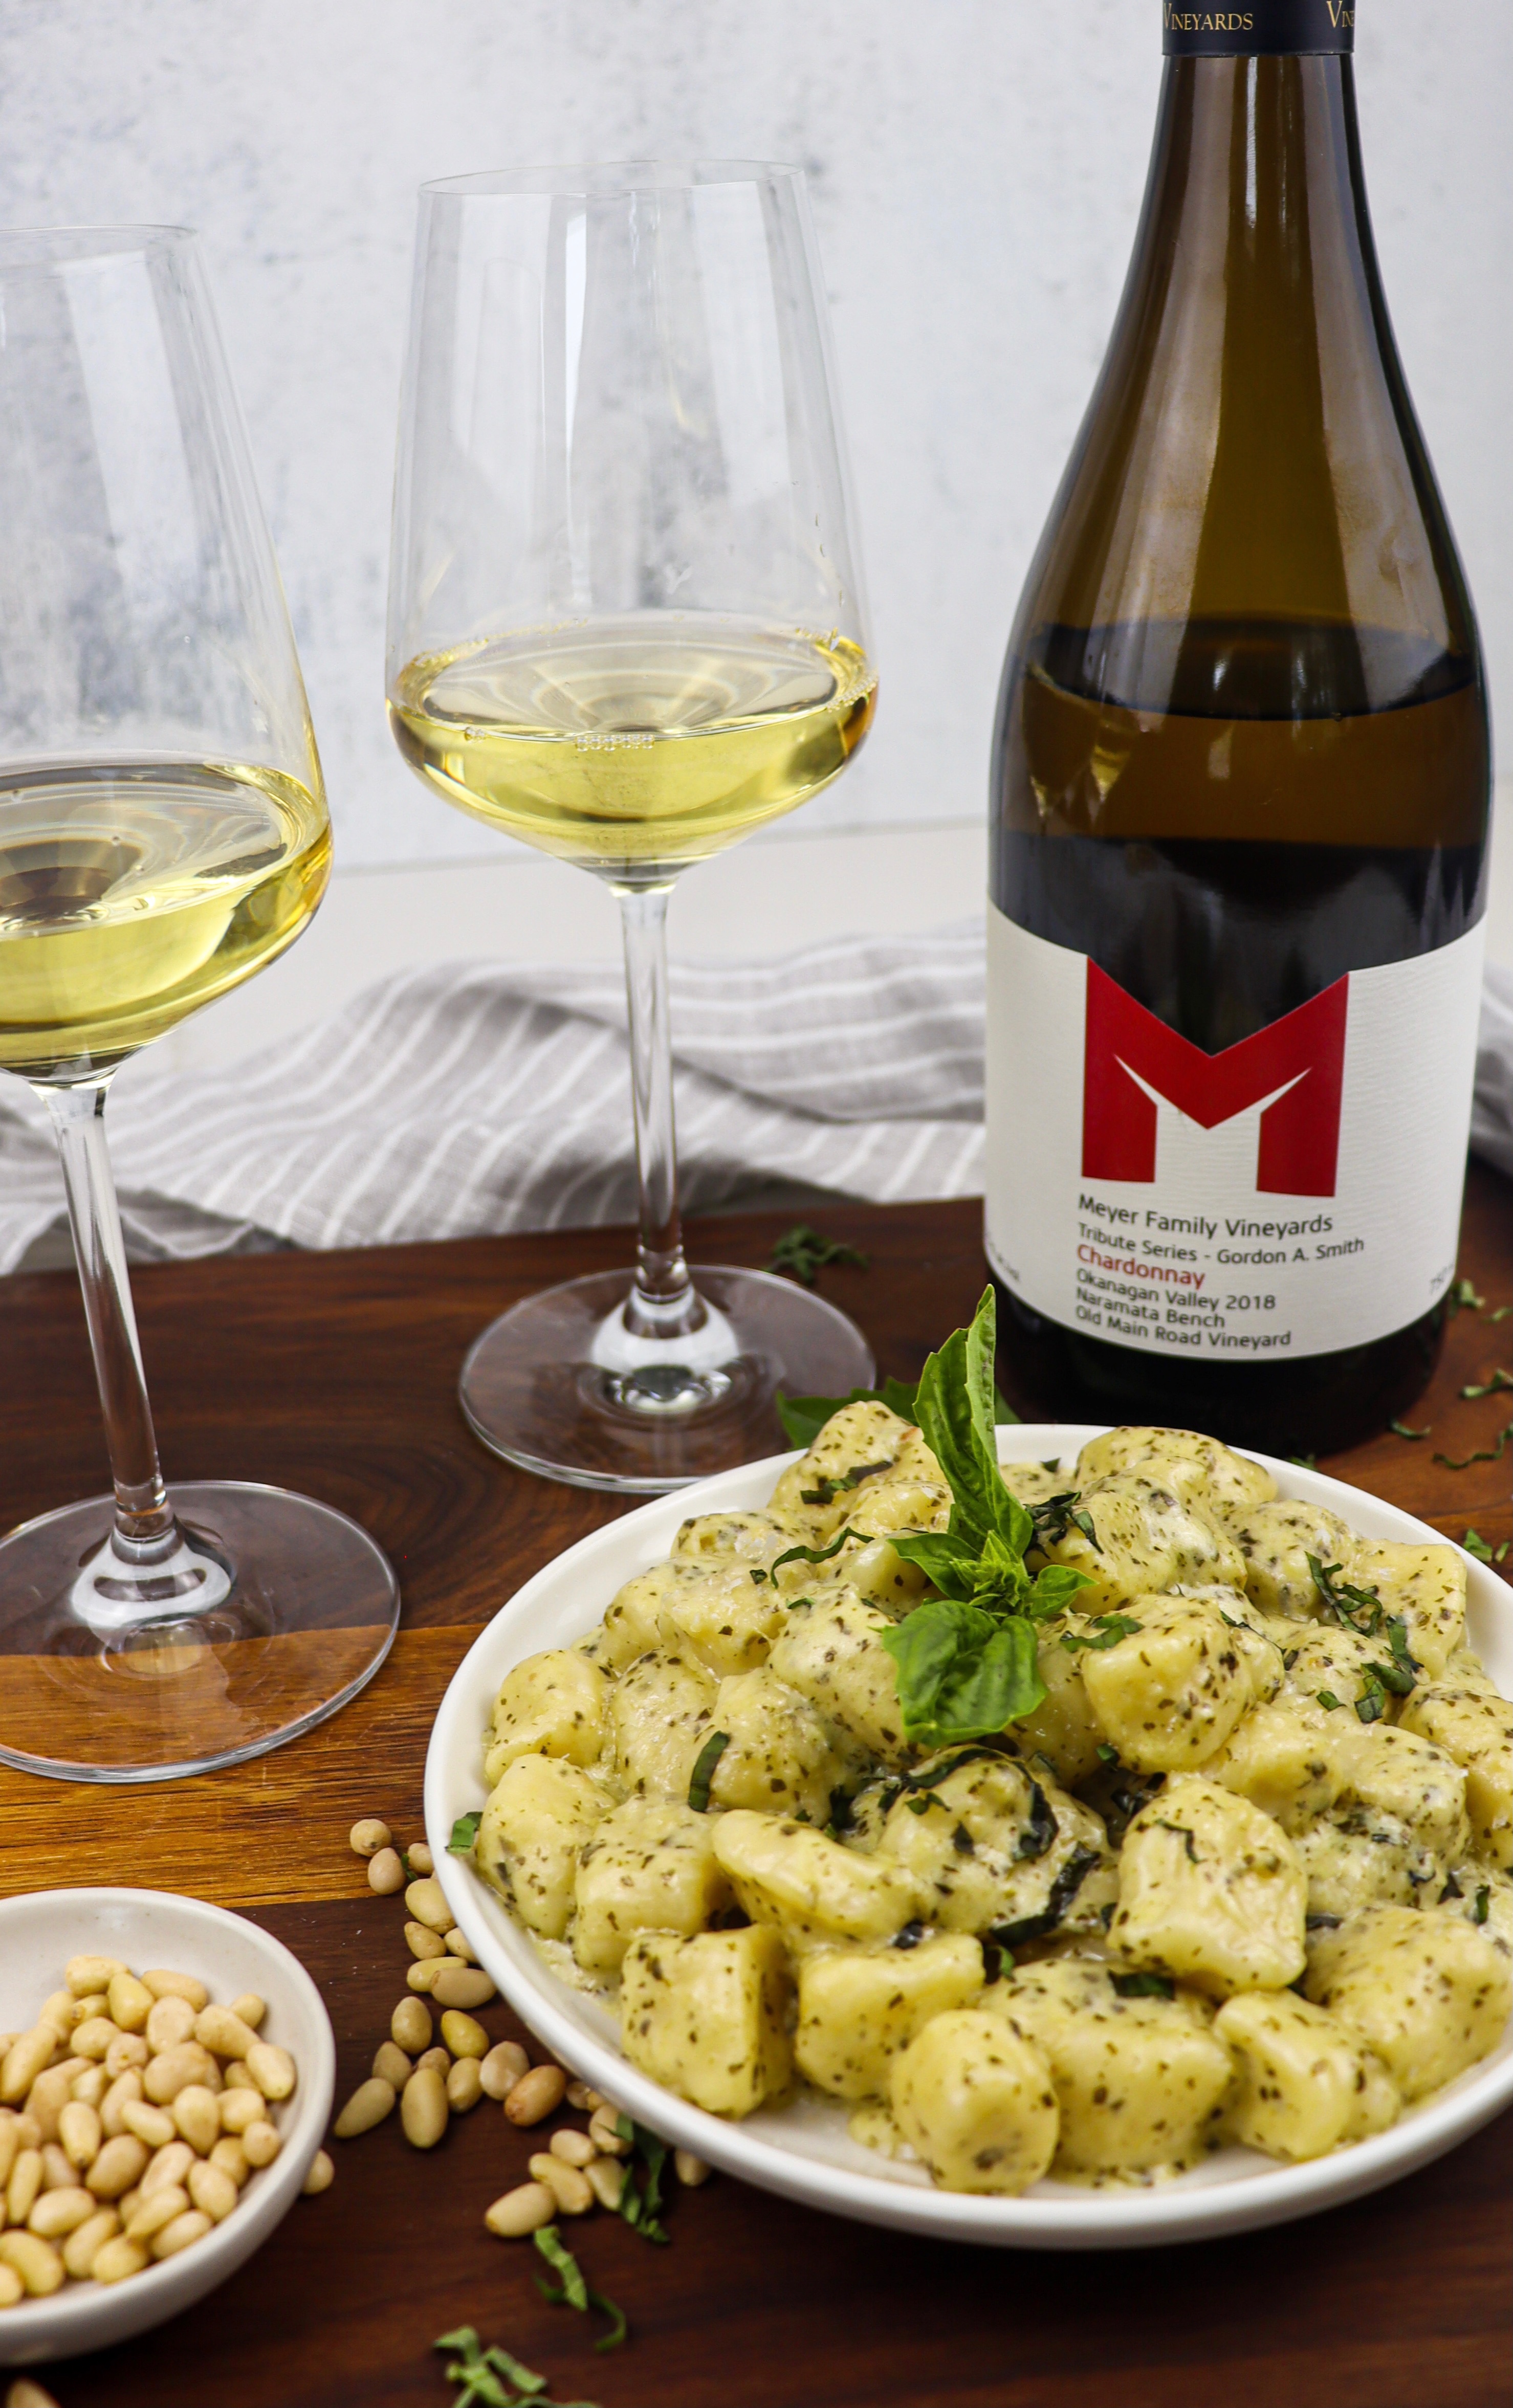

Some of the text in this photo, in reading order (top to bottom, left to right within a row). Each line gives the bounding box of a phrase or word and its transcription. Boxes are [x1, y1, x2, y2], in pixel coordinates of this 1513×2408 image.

[1079, 1194, 1333, 1240] Meyer Family Vineyards
[1079, 1223, 1135, 1250] Tribute
[1143, 1241, 1197, 1261] Series
[1217, 1249, 1286, 1263] Gordon
[1293, 1249, 1309, 1261] A.
[1316, 1238, 1364, 1259] Smith
[1077, 1244, 1205, 1290] Chardonnay
[1077, 1268, 1276, 1311] Okanagan Valley 2018
[1077, 1288, 1225, 1328] Naramata Bench
[1076, 1305, 1291, 1351] Old Main Road Vineyard
